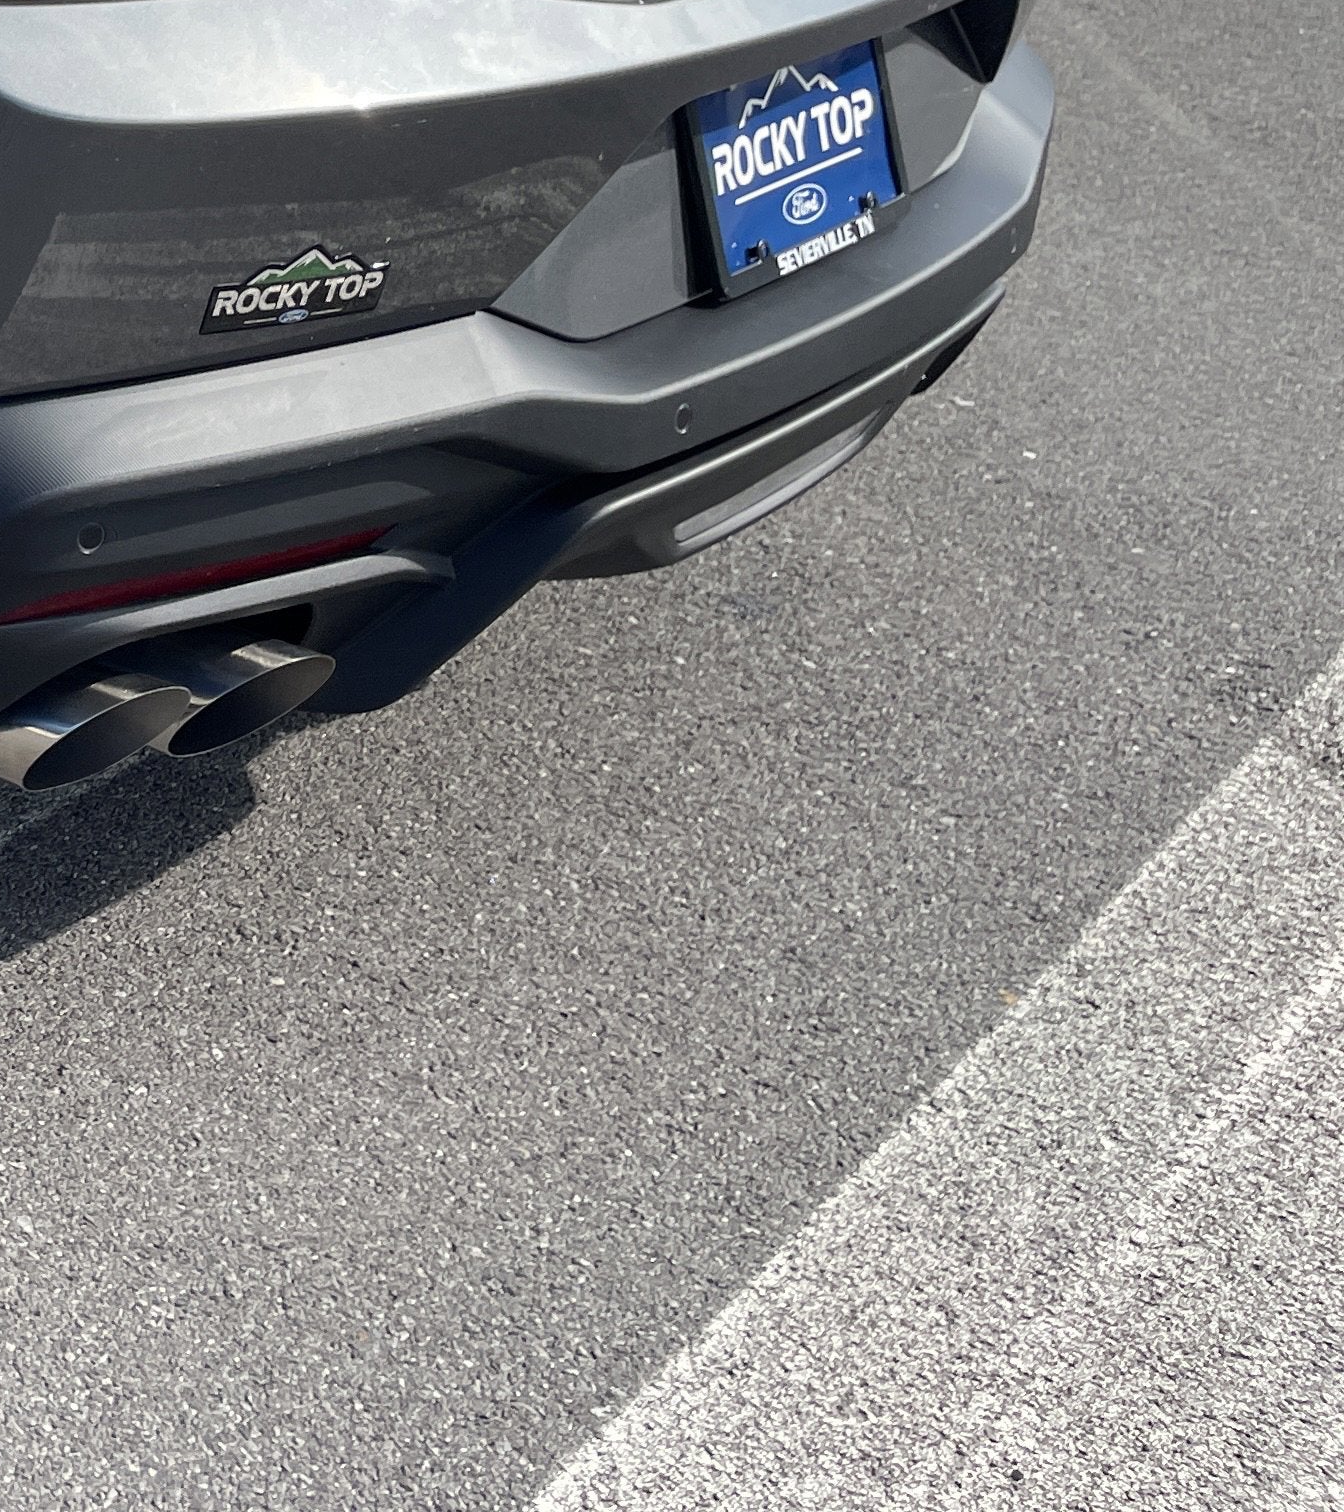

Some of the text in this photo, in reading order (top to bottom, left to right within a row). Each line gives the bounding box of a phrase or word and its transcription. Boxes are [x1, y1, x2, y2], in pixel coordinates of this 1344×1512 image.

[712, 88, 874, 196] ROCKY TOP
[855, 208, 876, 238] TN
[212, 271, 384, 317] ROCKY TOP
